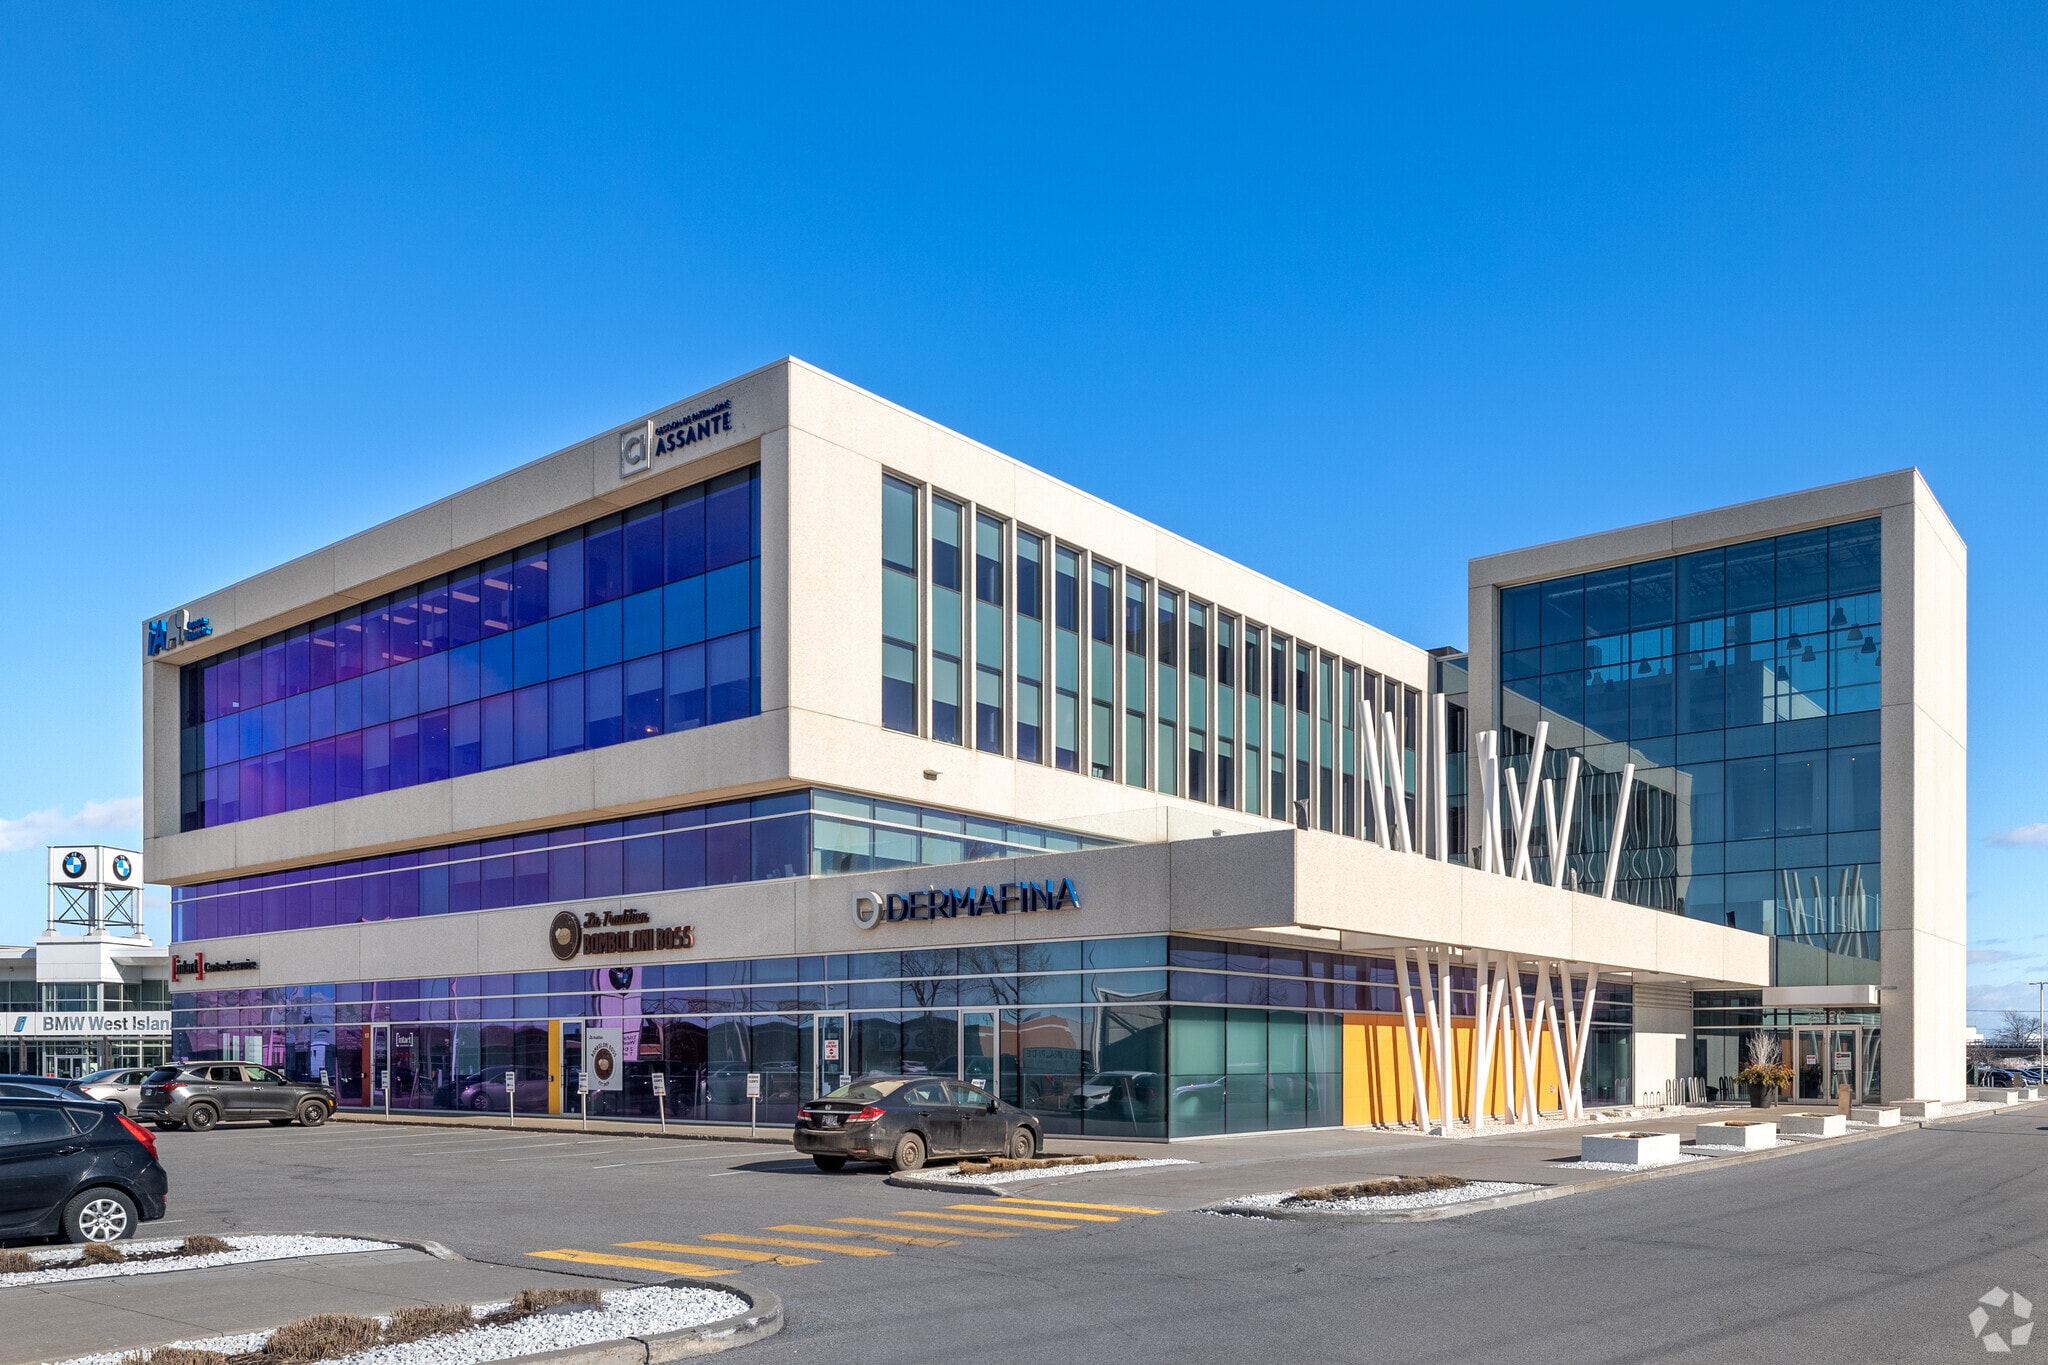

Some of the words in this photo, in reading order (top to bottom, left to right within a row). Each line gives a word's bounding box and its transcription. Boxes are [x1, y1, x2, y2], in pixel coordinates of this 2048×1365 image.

[655, 411, 732, 457] ASSANTE
[886, 877, 1082, 922] DERMAFINA
[583, 911, 601, 928] La
[602, 908, 650, 927] Tradition
[583, 929, 654, 955] BOMBOLONI
[656, 925, 695, 950] BOSS
[43, 1016, 85, 1031] BMW
[88, 1016, 128, 1031] West
[132, 1015, 171, 1031] Islan
